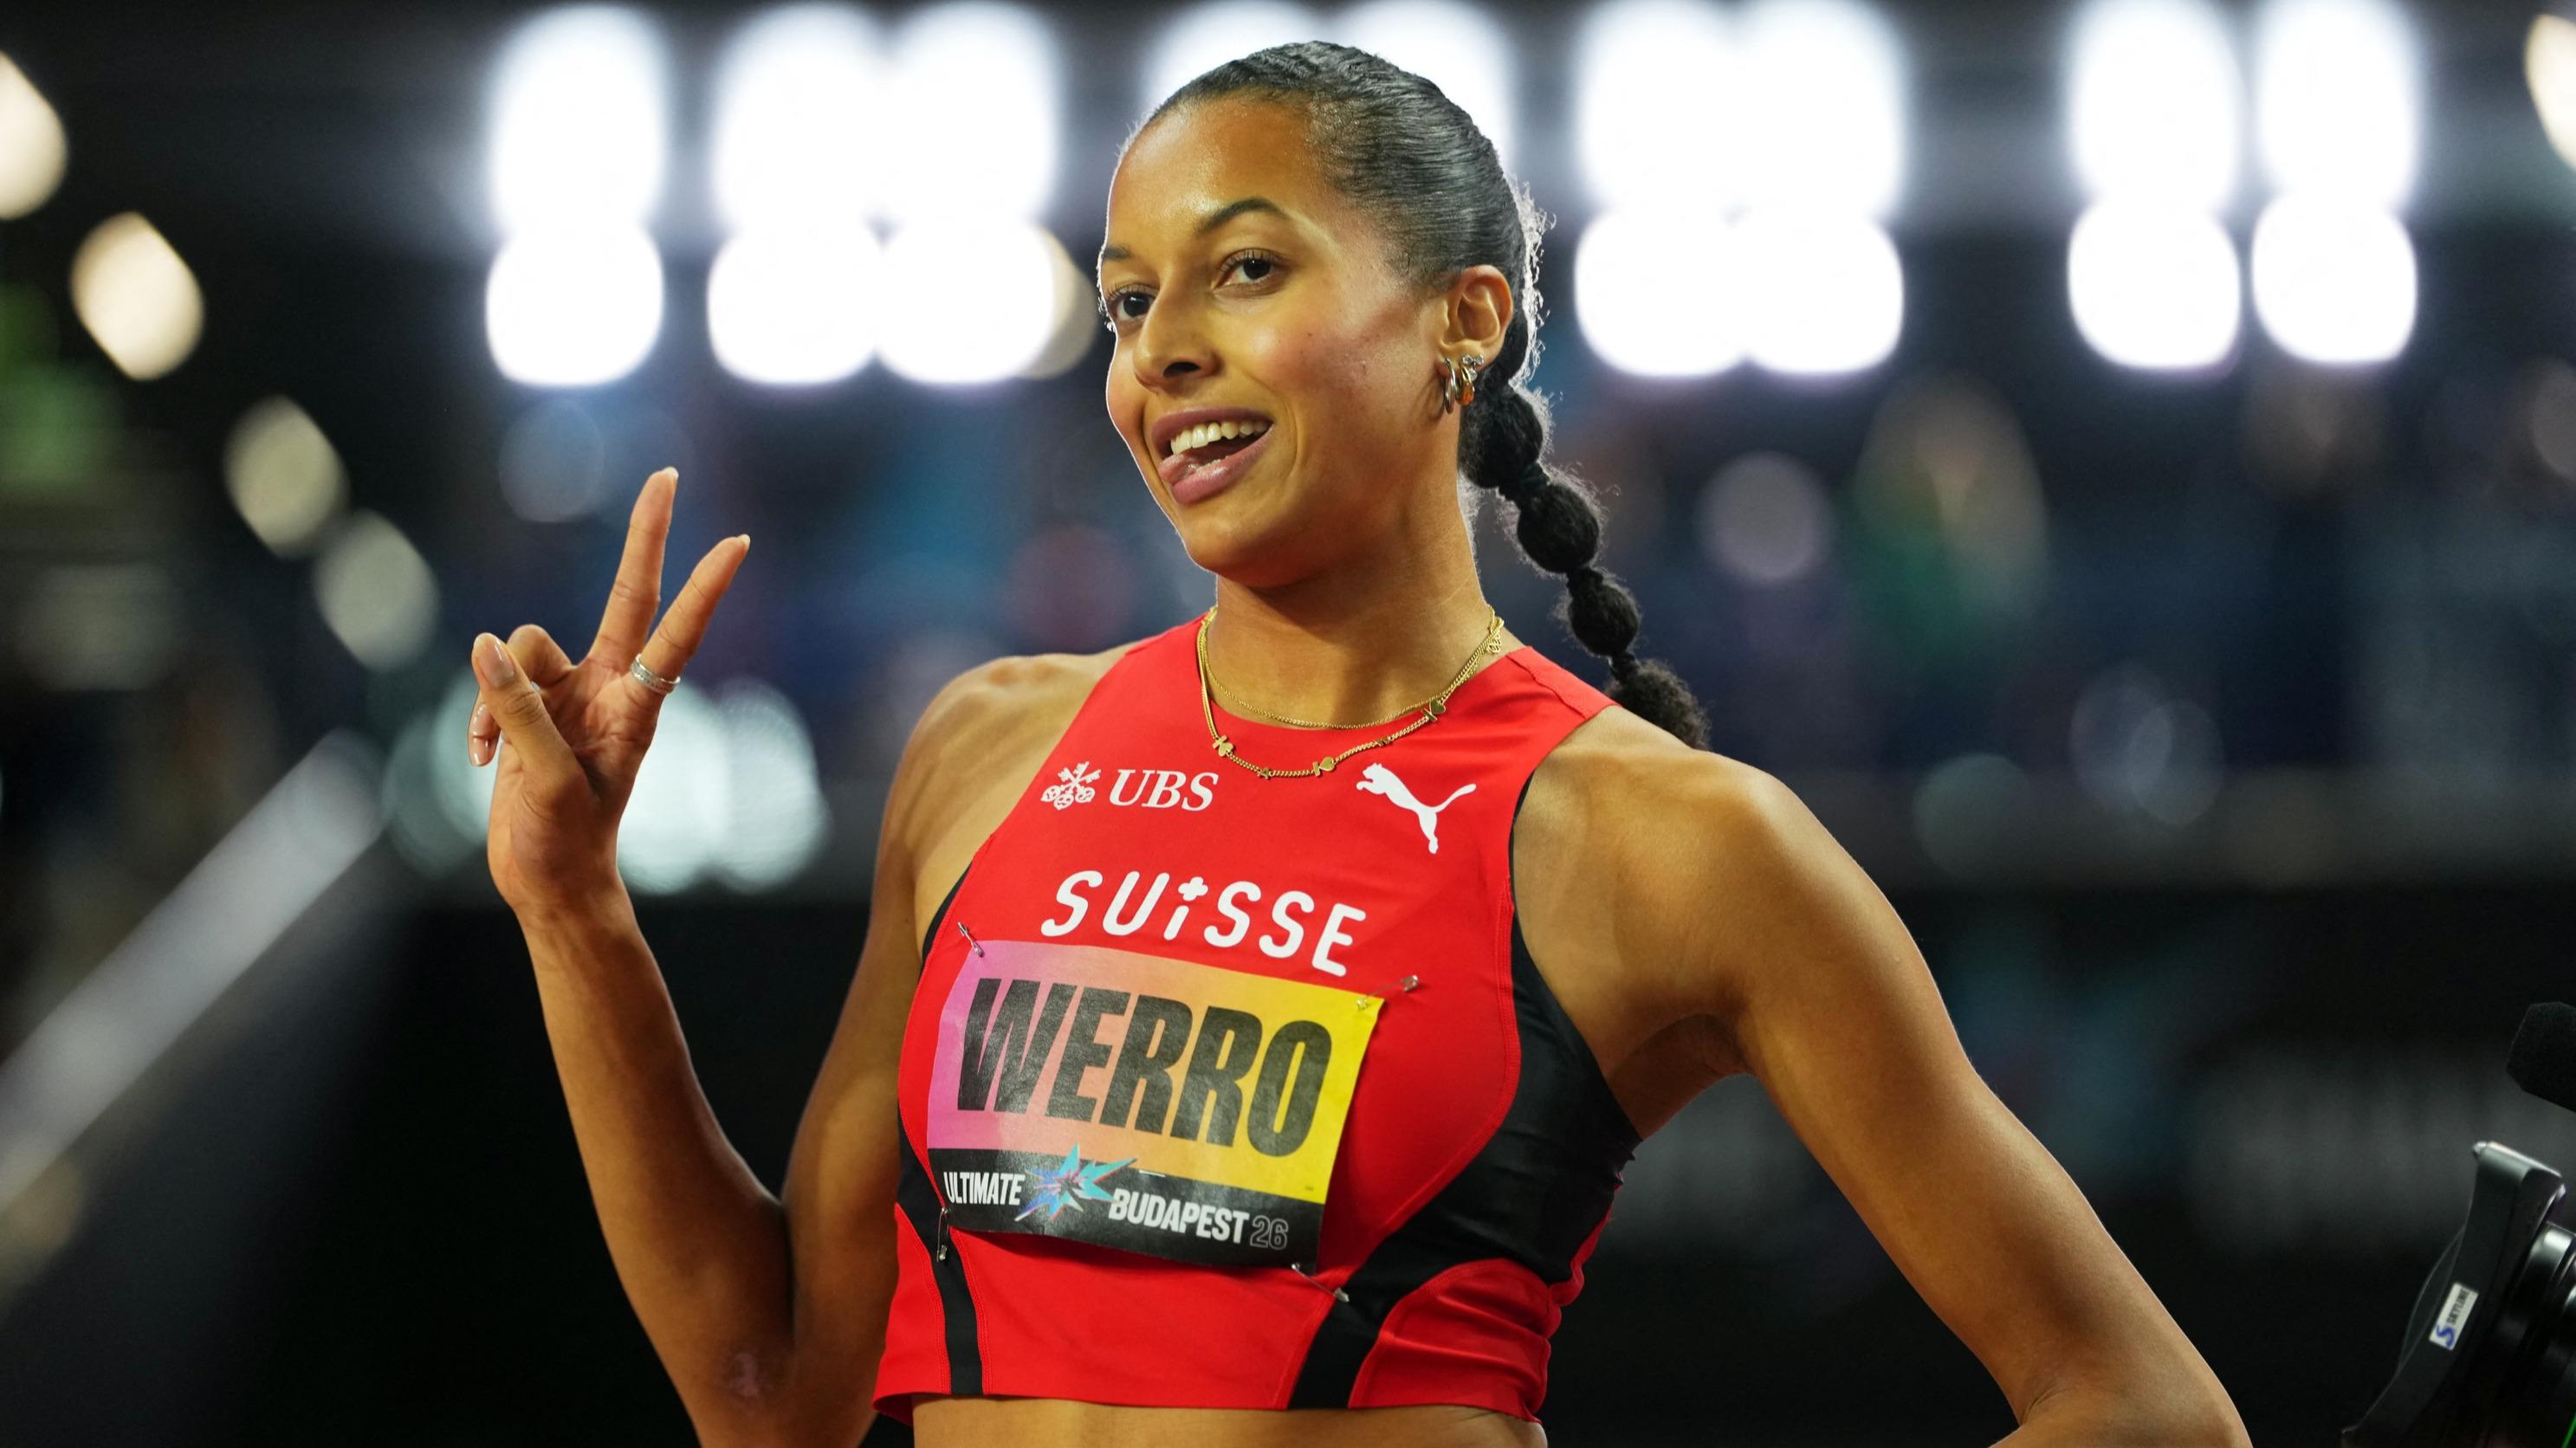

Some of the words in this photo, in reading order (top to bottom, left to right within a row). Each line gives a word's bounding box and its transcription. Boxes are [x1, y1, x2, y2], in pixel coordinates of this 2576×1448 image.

[1109, 769, 1219, 811] UBS
[956, 978, 1332, 1158] WERRO
[943, 1171, 1026, 1206] ULTIMATE
[1108, 1187, 1250, 1244] BUDAPEST
[1249, 1214, 1289, 1251] 26
